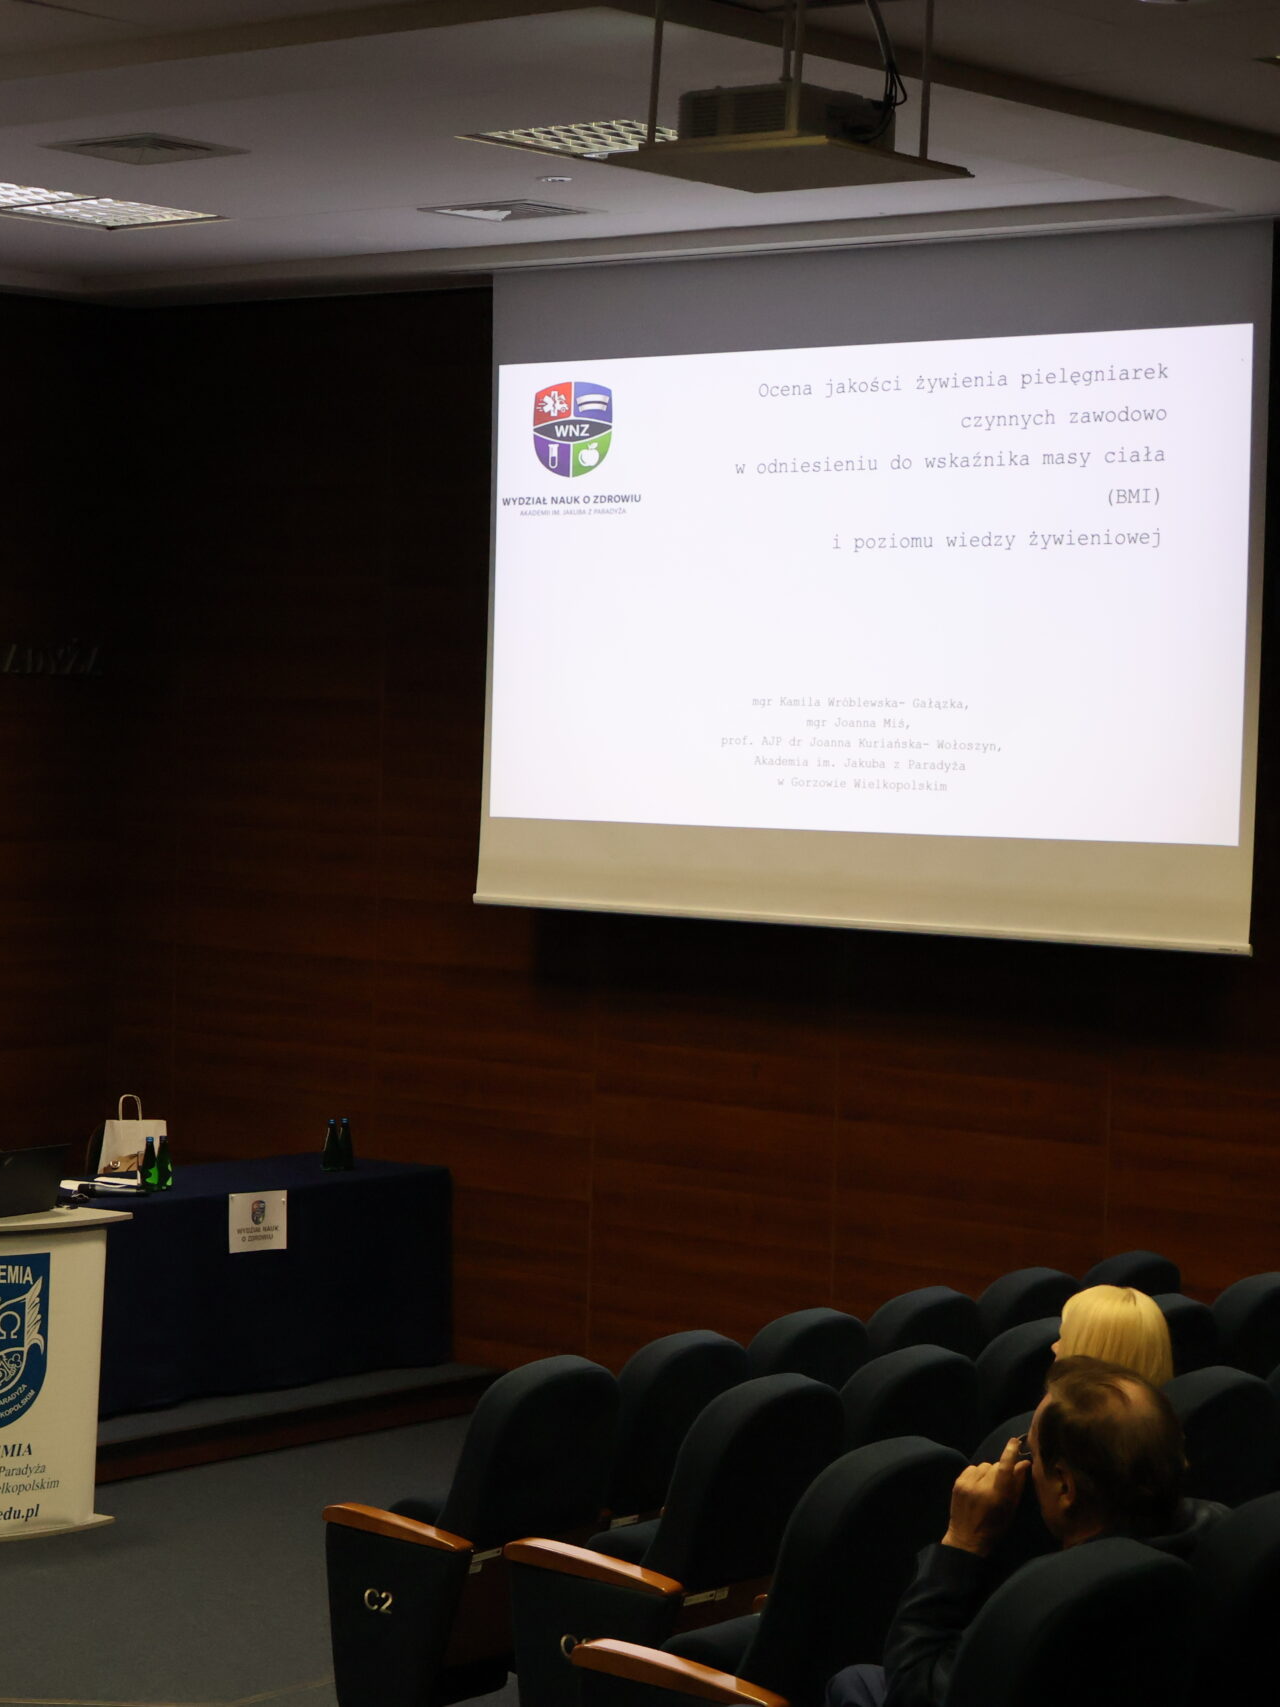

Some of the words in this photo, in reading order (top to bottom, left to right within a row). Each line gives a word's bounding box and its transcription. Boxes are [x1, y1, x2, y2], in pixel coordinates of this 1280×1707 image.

[758, 382, 813, 398] Ocena
[826, 376, 902, 398] jakości
[916, 371, 1008, 393] żywienia
[1021, 363, 1168, 389] pielęgniarek
[961, 409, 1055, 431] czynnych
[1070, 406, 1167, 423] zawodowo
[555, 424, 590, 437] WNZ
[735, 463, 746, 475] w
[757, 456, 877, 474] odniesieniu
[890, 454, 912, 470] do
[925, 451, 1029, 468] wskaźnika
[1042, 451, 1091, 468] masy
[1105, 446, 1164, 463] ciała
[502, 496, 547, 506] WYDZIAŁ
[551, 496, 579, 505] NAUK
[583, 495, 590, 504] O
[593, 494, 641, 503] ZDROWIU
[1109, 488, 1159, 506] (BMI)
[832, 534, 841, 550] i
[854, 533, 933, 552] poziomu
[946, 532, 1015, 550] wiedzy
[1029, 528, 1160, 549] żywieniowej
[752, 698, 772, 708] mgr
[780, 696, 821, 706] Kamila
[806, 718, 827, 729] mgr
[834, 717, 876, 728] Joanna
[721, 736, 754, 748] prof.
[761, 736, 782, 746] AJP
[789, 736, 803, 746] dr
[810, 737, 851, 748] Joanna
[754, 756, 808, 767] Akademia
[817, 758, 836, 768] im.
[844, 758, 886, 768] Jakuba
[908, 760, 966, 773] Paradyża
[791, 777, 846, 788] Gorzowie
[854, 779, 947, 792] Wielkopolskim
[363, 1588, 393, 1615] C2
